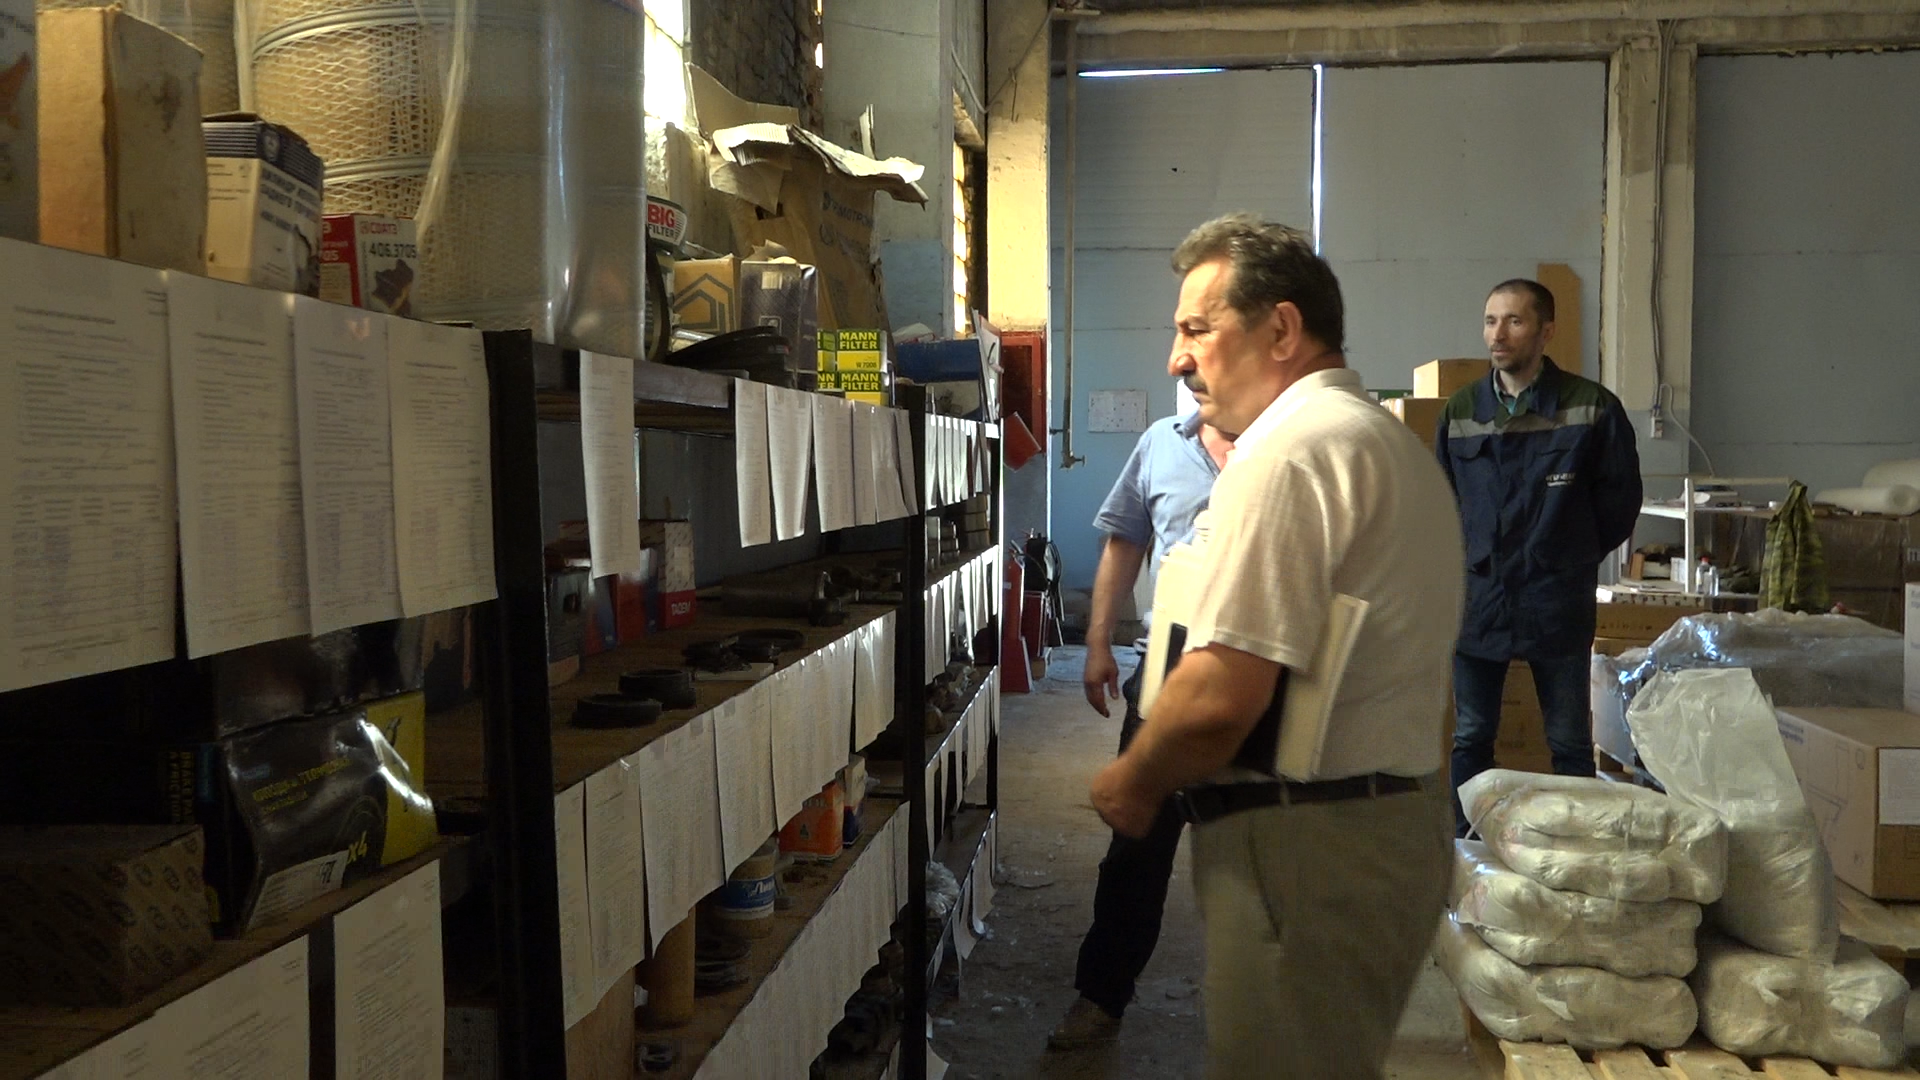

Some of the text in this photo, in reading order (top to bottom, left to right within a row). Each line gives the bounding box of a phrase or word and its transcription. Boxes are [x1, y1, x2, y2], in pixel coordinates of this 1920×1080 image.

[648, 204, 675, 228] BIG
[649, 224, 676, 238] FILTER
[369, 243, 417, 258] 406.3705
[839, 332, 877, 340] MANN
[839, 341, 877, 349] FILTER
[841, 373, 879, 381] MANN
[841, 382, 879, 391] FILTER
